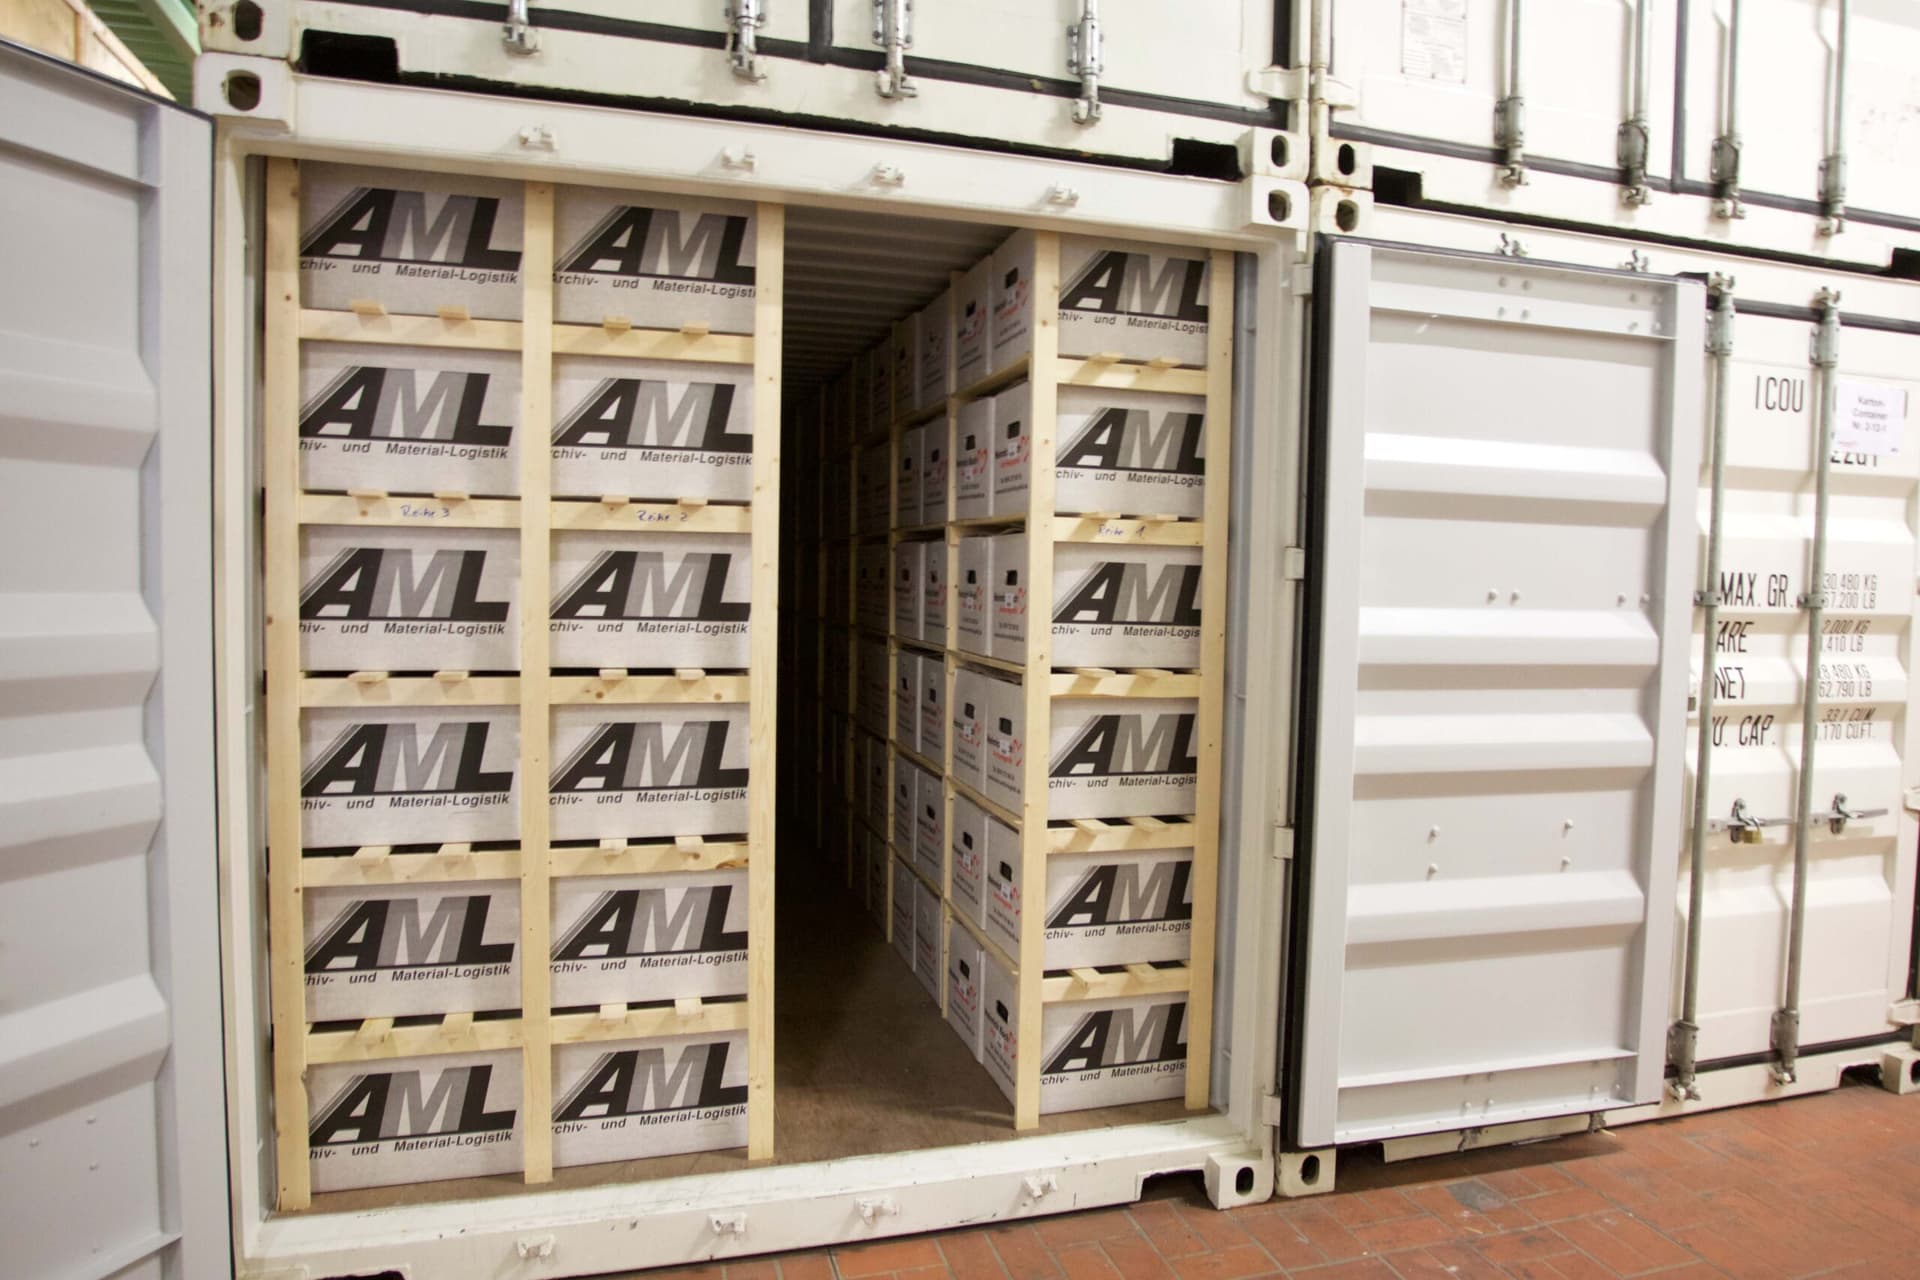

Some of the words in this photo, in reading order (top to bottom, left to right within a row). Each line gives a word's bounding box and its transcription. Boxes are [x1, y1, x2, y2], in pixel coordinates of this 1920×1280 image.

[299, 187, 522, 271] AML
[553, 206, 755, 286] AML
[352, 263, 381, 274] und
[396, 265, 517, 284] Material-Logistik
[613, 279, 639, 289] und
[1059, 250, 1208, 323] AML
[1094, 316, 1116, 325] und
[1755, 375, 1804, 413] ICOU
[299, 366, 513, 446] AML
[552, 377, 753, 453] AML
[343, 442, 371, 453] und
[386, 443, 508, 460] Material-Logistik
[1056, 407, 1205, 475] AML
[600, 451, 627, 460] und
[640, 451, 752, 466] Material-Logistik
[1095, 472, 1116, 481] und
[441, 507, 450, 518] 3
[680, 511, 688, 521] 2
[299, 548, 509, 622] AML
[549, 550, 751, 621] AML
[1720, 571, 1760, 608] MAX.
[1767, 574, 1794, 609] GR.
[1863, 573, 1877, 591] KG
[1052, 562, 1202, 626] AML
[1863, 592, 1876, 609] LB
[341, 623, 368, 634] und
[384, 623, 504, 637] Material-Logistik
[597, 622, 623, 633] und
[637, 622, 747, 636] Material-Logistik
[1091, 626, 1112, 635] und
[1855, 619, 1871, 635] KG
[1850, 635, 1864, 652] LB
[1713, 666, 1746, 700] NET
[1859, 681, 1872, 698] LB
[1739, 715, 1776, 747] CAP.
[549, 721, 749, 793] AML
[1049, 714, 1197, 777] AML
[301, 722, 513, 797] AML
[1088, 778, 1108, 787] und
[347, 798, 374, 809] und
[389, 794, 509, 808] Material-Logistik
[597, 793, 623, 804] und
[637, 789, 746, 803] Material-Logistik
[1045, 861, 1192, 929] AML
[304, 895, 514, 973] AML
[550, 885, 748, 961] AML
[1085, 928, 1105, 937] und
[600, 960, 626, 971] und
[640, 953, 748, 968] Material-Logistik
[350, 972, 376, 984] und
[392, 965, 510, 981] Material-Logistik
[1041, 1002, 1186, 1075] AML
[552, 1042, 748, 1123] AML
[1080, 1071, 1100, 1081] und
[309, 1064, 516, 1148] AML
[601, 1118, 626, 1130] und
[640, 1105, 746, 1126] Material-Logistik
[352, 1144, 379, 1155] und
[394, 1132, 512, 1152] Material-Logistik
